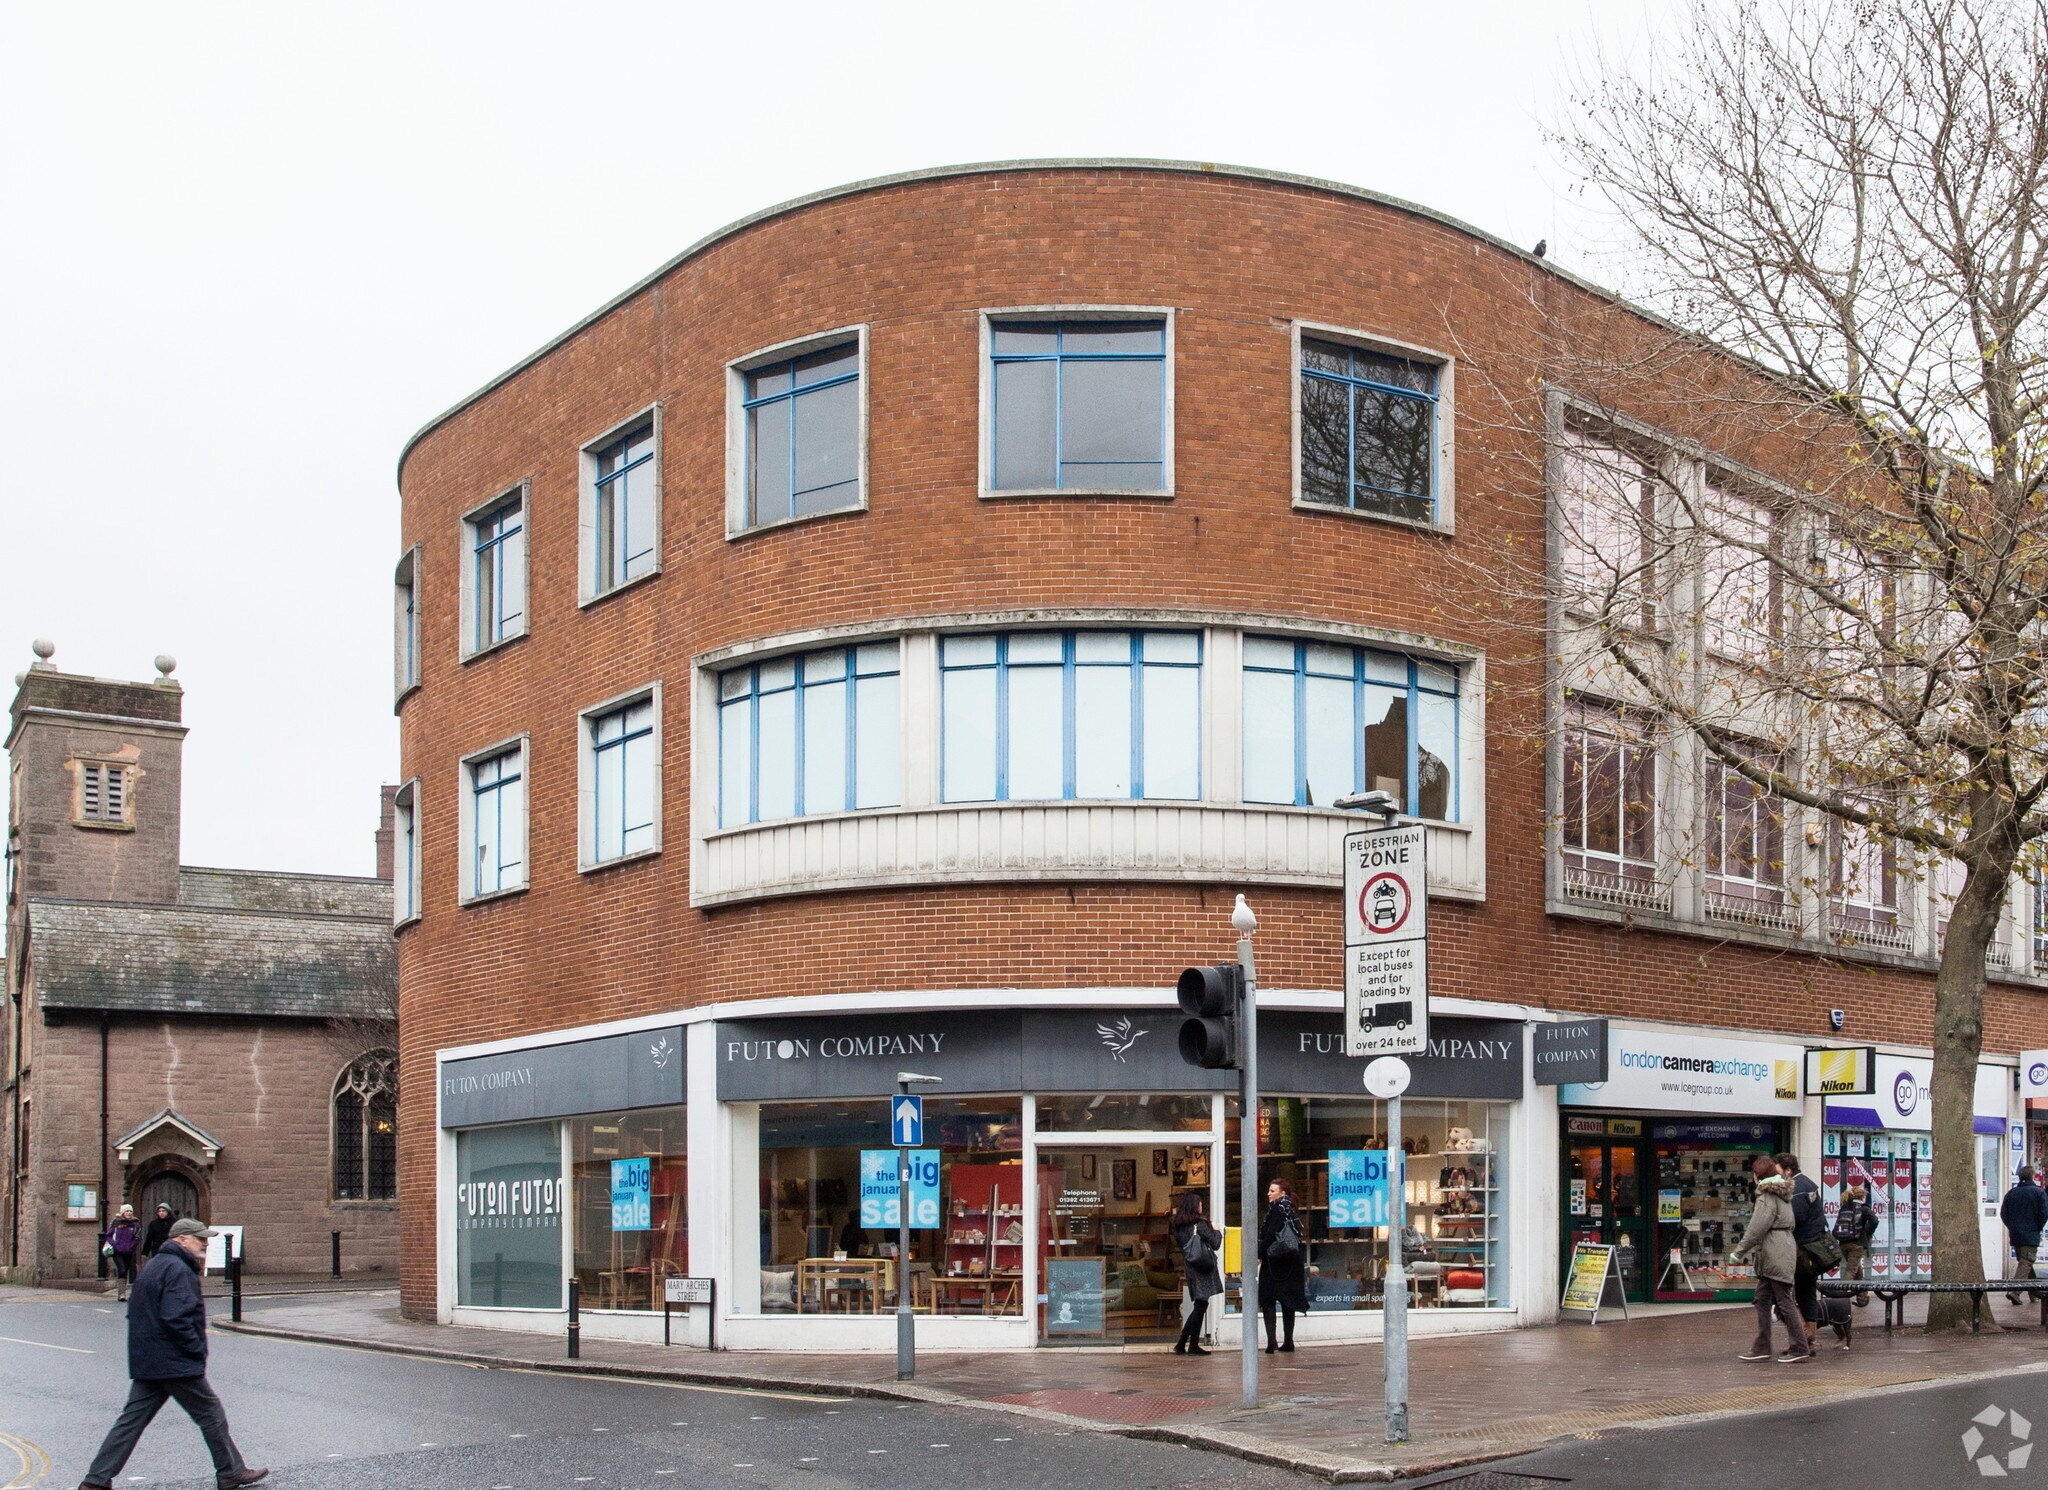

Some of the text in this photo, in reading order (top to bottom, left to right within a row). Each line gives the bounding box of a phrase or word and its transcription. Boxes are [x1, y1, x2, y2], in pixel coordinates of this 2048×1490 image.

[1350, 833, 1419, 851] PEDESTRIAN
[1360, 848, 1409, 869] ZONE
[1360, 949, 1411, 961] Except for
[1358, 961, 1413, 974] local buses
[1368, 974, 1403, 985] and for
[1360, 985, 1411, 998] loading by
[1547, 1026, 1589, 1041] FUTON
[727, 1033, 945, 1061] FUTON COMPANY
[1299, 1033, 1512, 1060] FUT MPANY
[1356, 1036, 1417, 1050] over 24 feet
[1537, 1048, 1599, 1064] COMPANY
[446, 1067, 534, 1096] FUTON COMPANY
[2032, 1070, 2045, 1080] go
[1661, 1081, 1734, 1096] www.lcegroup.co.uk
[1820, 1080, 1854, 1092] Nikon
[1775, 1087, 1797, 1100] Nikon
[1899, 1085, 1912, 1104] go
[1569, 1118, 1602, 1132] Canon
[1613, 1123, 1636, 1134] Nikon
[1850, 1138, 1862, 1150] sky
[876, 1170, 896, 1181] the
[1344, 1156, 1404, 1185] the bi
[1823, 1166, 1839, 1176] SALE
[1848, 1167, 1863, 1177] SALE
[1872, 1168, 1887, 1177] SALE
[1895, 1168, 1910, 1177] SALE
[619, 1164, 650, 1192] the big
[861, 1183, 900, 1197] januar
[1330, 1183, 1375, 1197] january
[458, 1181, 507, 1216] FUTON
[612, 1191, 634, 1203] january
[612, 1195, 650, 1227] sale
[861, 1190, 938, 1225] sale
[511, 1216, 561, 1229] COMPAN
[1872, 1255, 1888, 1266] SALE
[1895, 1255, 1910, 1265] SALE
[1918, 1255, 1931, 1265] SALE
[667, 1280, 709, 1290] MARY ARCHES
[677, 1291, 698, 1301] STREET
[1315, 1293, 1385, 1303] experts in small spa
